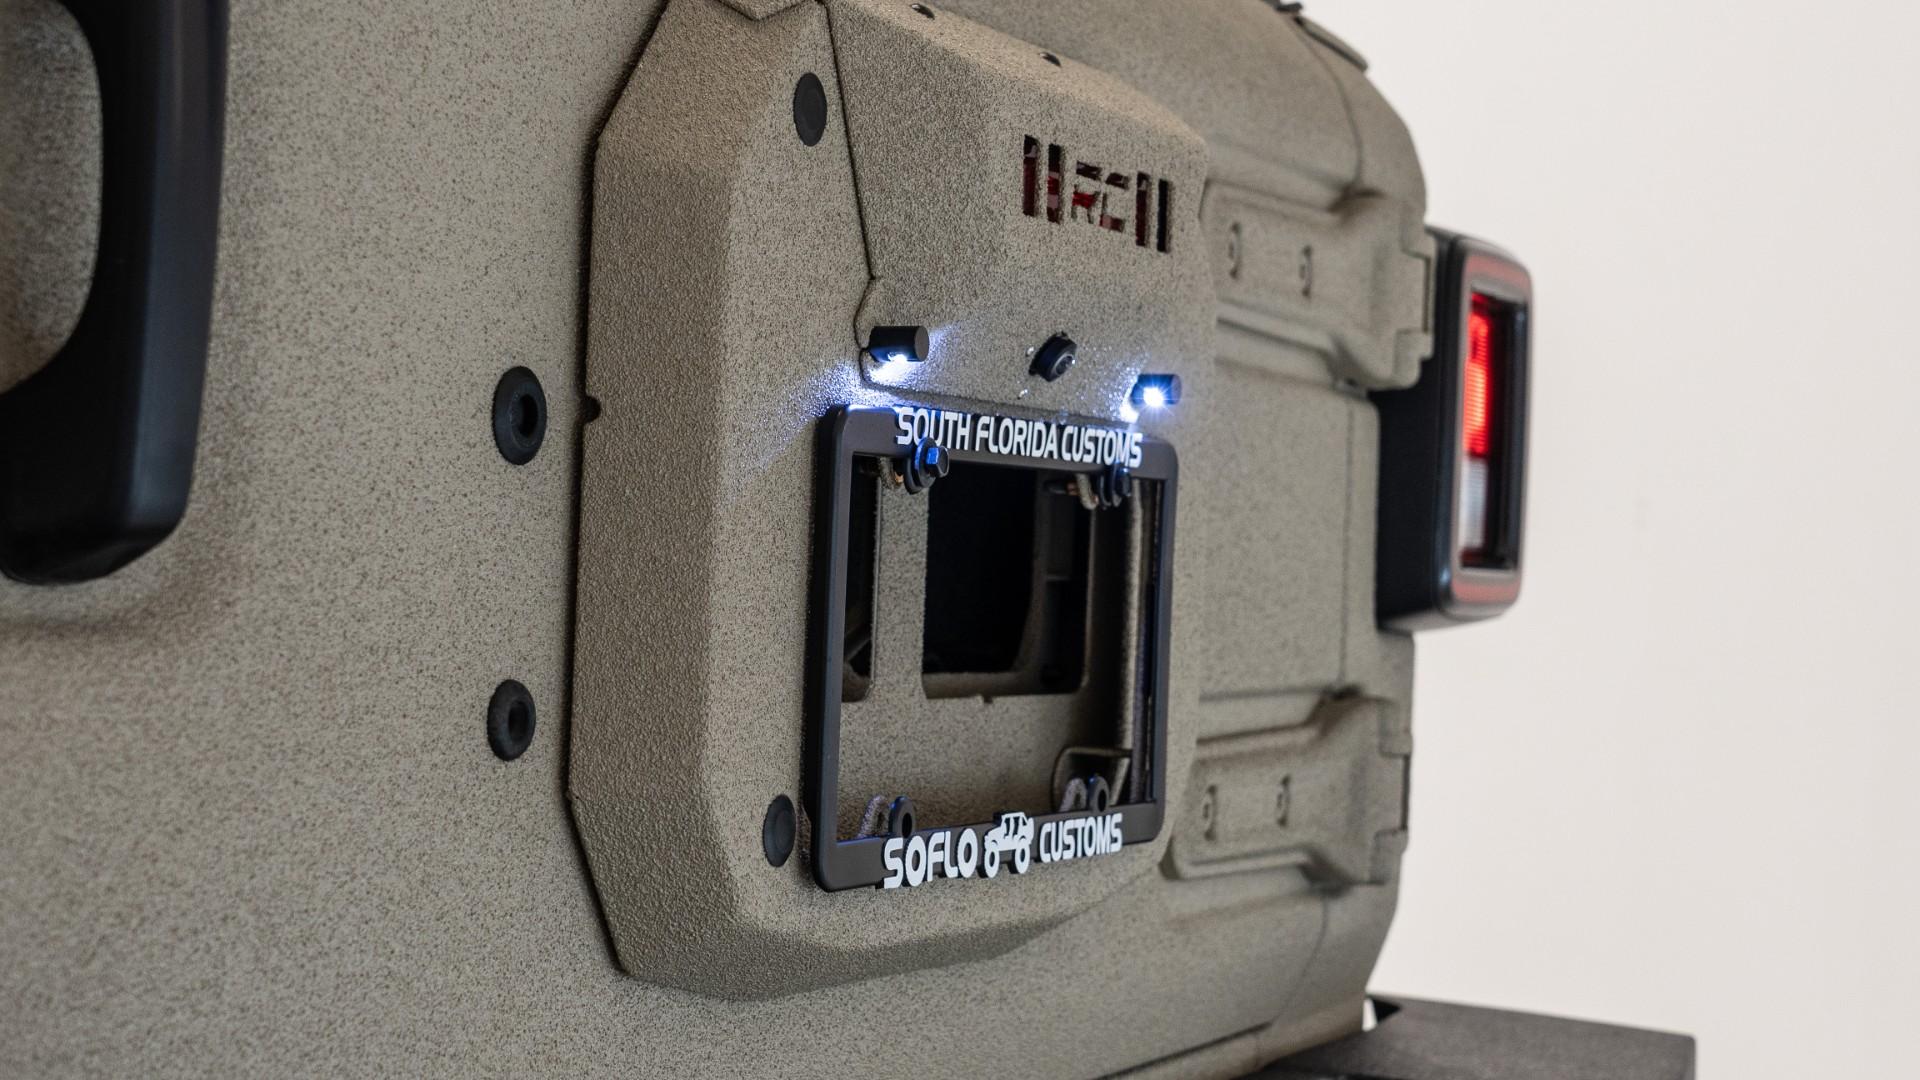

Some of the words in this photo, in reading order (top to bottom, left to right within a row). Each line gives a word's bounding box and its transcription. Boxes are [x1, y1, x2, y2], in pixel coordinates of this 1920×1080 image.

[897, 406, 972, 451] SOUTH
[975, 415, 1058, 460] FLORIDA
[1061, 425, 1144, 468] CUSTOMS
[883, 828, 979, 889] SOFLO
[1039, 812, 1123, 863] CUSTOMS
